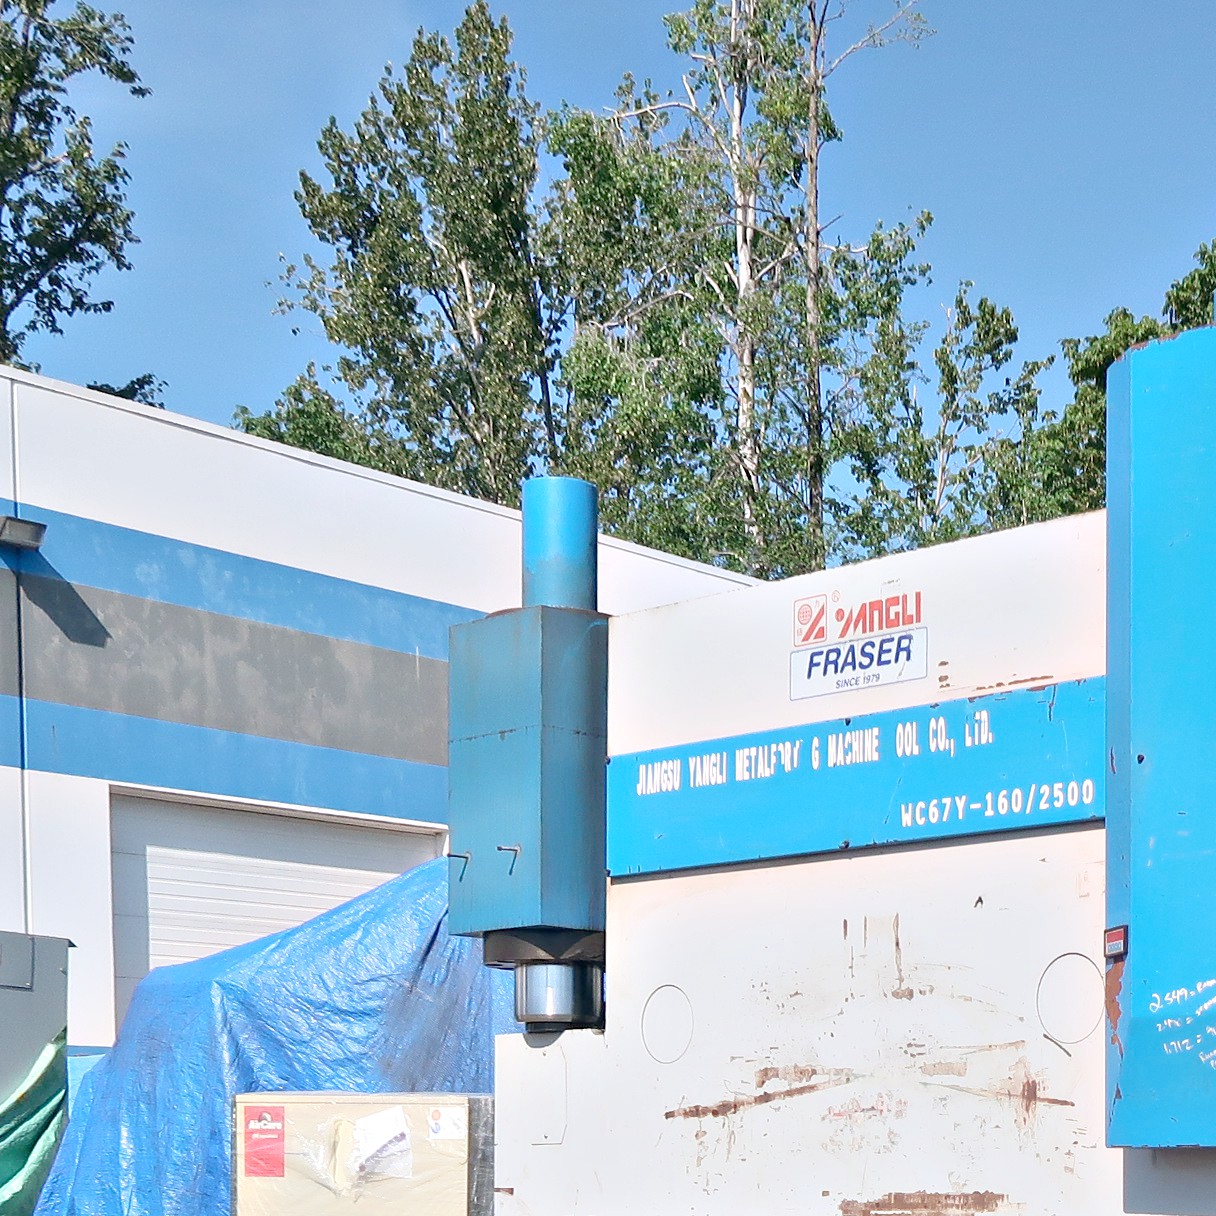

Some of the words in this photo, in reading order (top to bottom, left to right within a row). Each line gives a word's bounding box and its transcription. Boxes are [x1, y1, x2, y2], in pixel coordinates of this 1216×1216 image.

[806, 634, 914, 680] FRASER
[835, 676, 860, 689] SINCE
[862, 673, 881, 685] 1979
[636, 759, 681, 796] JIANGSU
[688, 751, 728, 788] YANGLI
[827, 727, 880, 768] MACHINE
[900, 779, 1095, 828] WC67Y-160/2500
